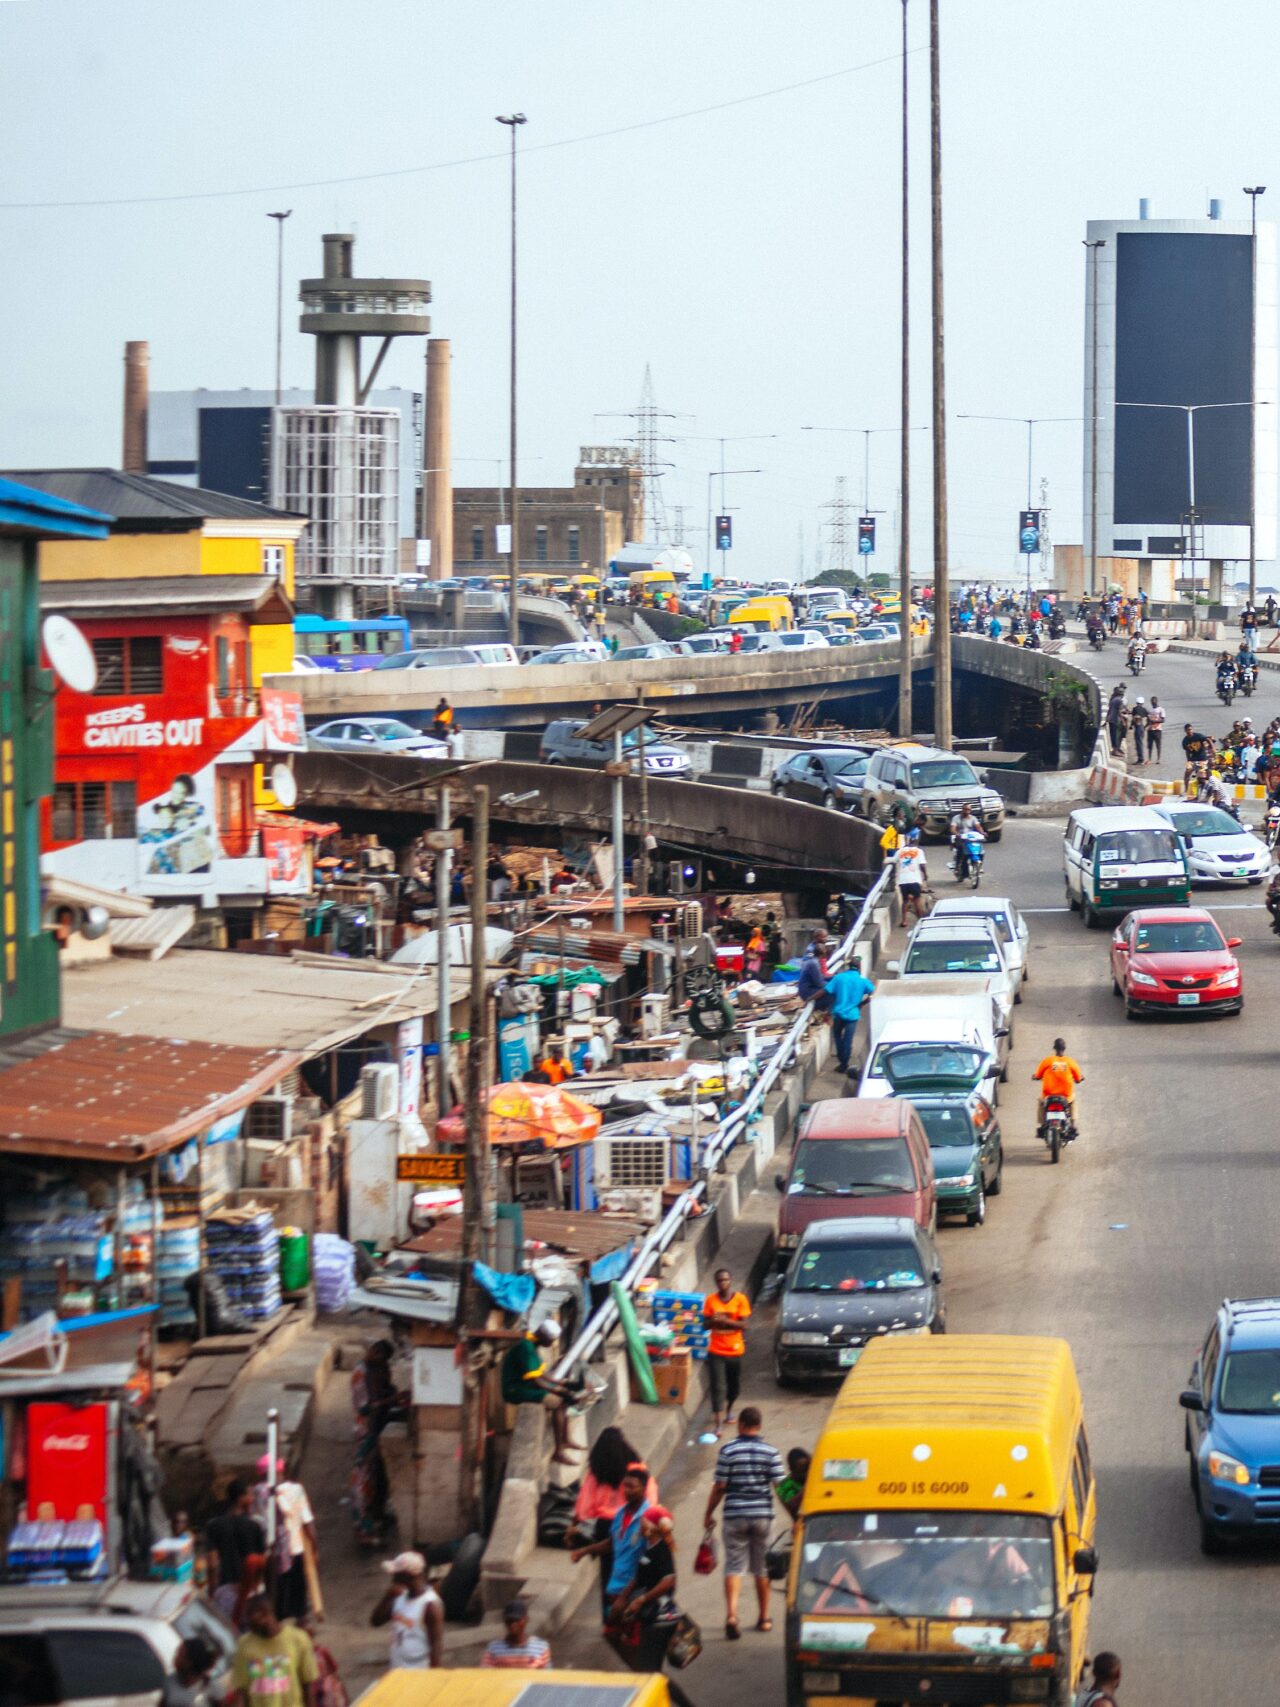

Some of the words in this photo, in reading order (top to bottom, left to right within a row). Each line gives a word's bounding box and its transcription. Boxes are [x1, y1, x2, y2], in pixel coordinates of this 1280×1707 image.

[86, 704, 146, 726] KEEPS
[84, 721, 164, 747] CAVITIES
[165, 718, 204, 746] OUT
[400, 1160, 456, 1177] SAVAGE
[878, 1482, 907, 1494] GOD
[912, 1482, 925, 1494] IS
[930, 1481, 969, 1494] GOOD
